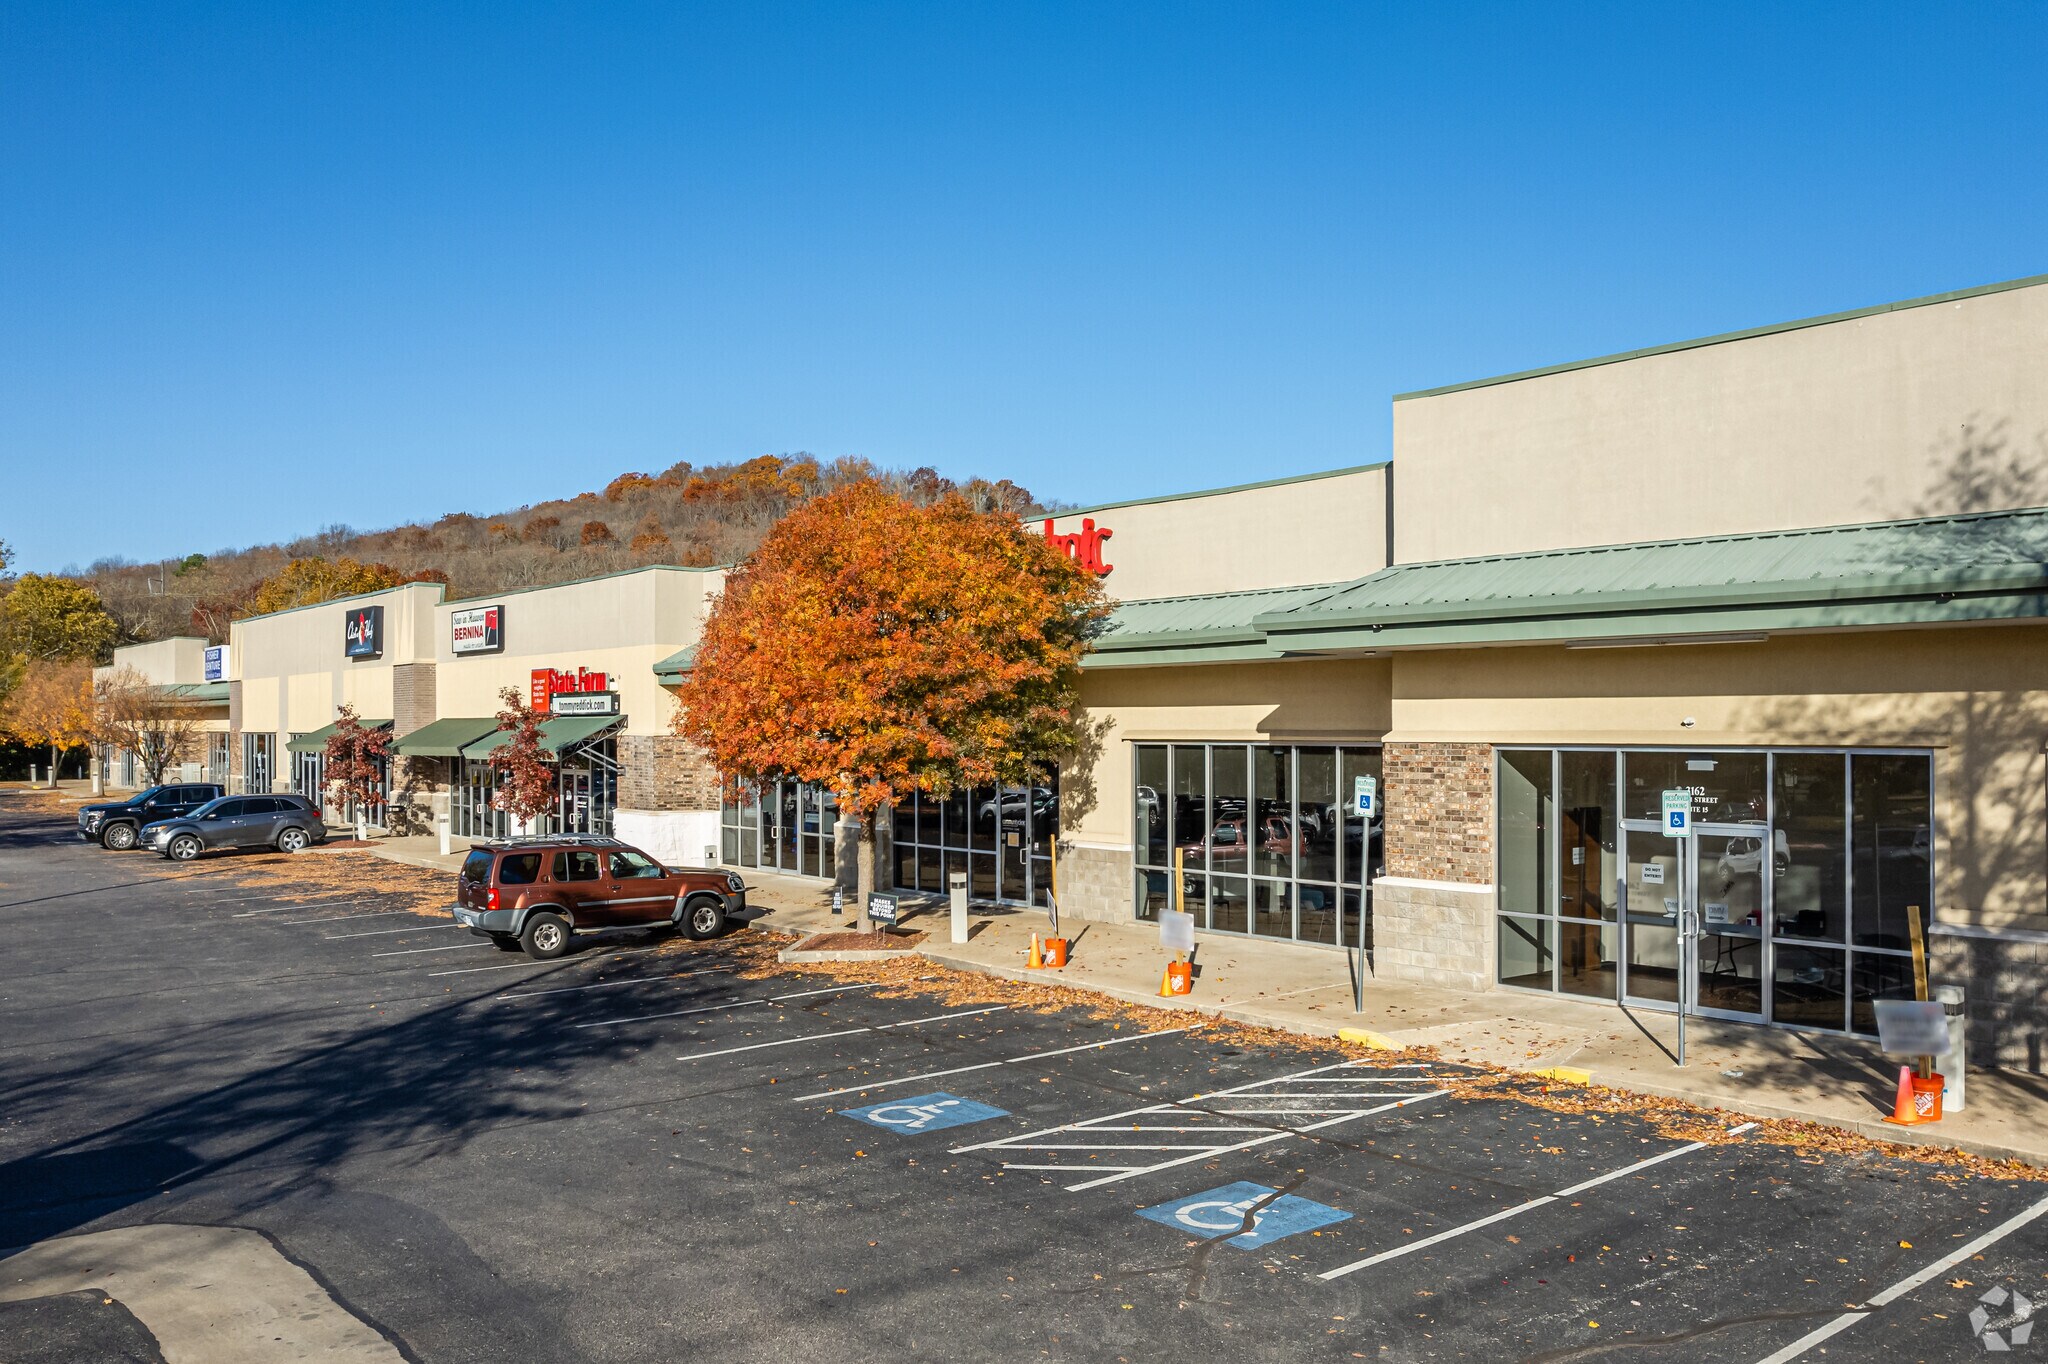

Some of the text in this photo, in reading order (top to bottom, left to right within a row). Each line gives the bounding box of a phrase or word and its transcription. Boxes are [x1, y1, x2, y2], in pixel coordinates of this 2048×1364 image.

[454, 624, 484, 641] BERNINA
[549, 666, 608, 693] State Farm
[558, 699, 605, 712] tommyreddick.com
[1694, 796, 1718, 804] STREET
[870, 902, 895, 911] REQUIRED
[873, 906, 892, 914] BEYOND
[880, 912, 895, 920] POINT
